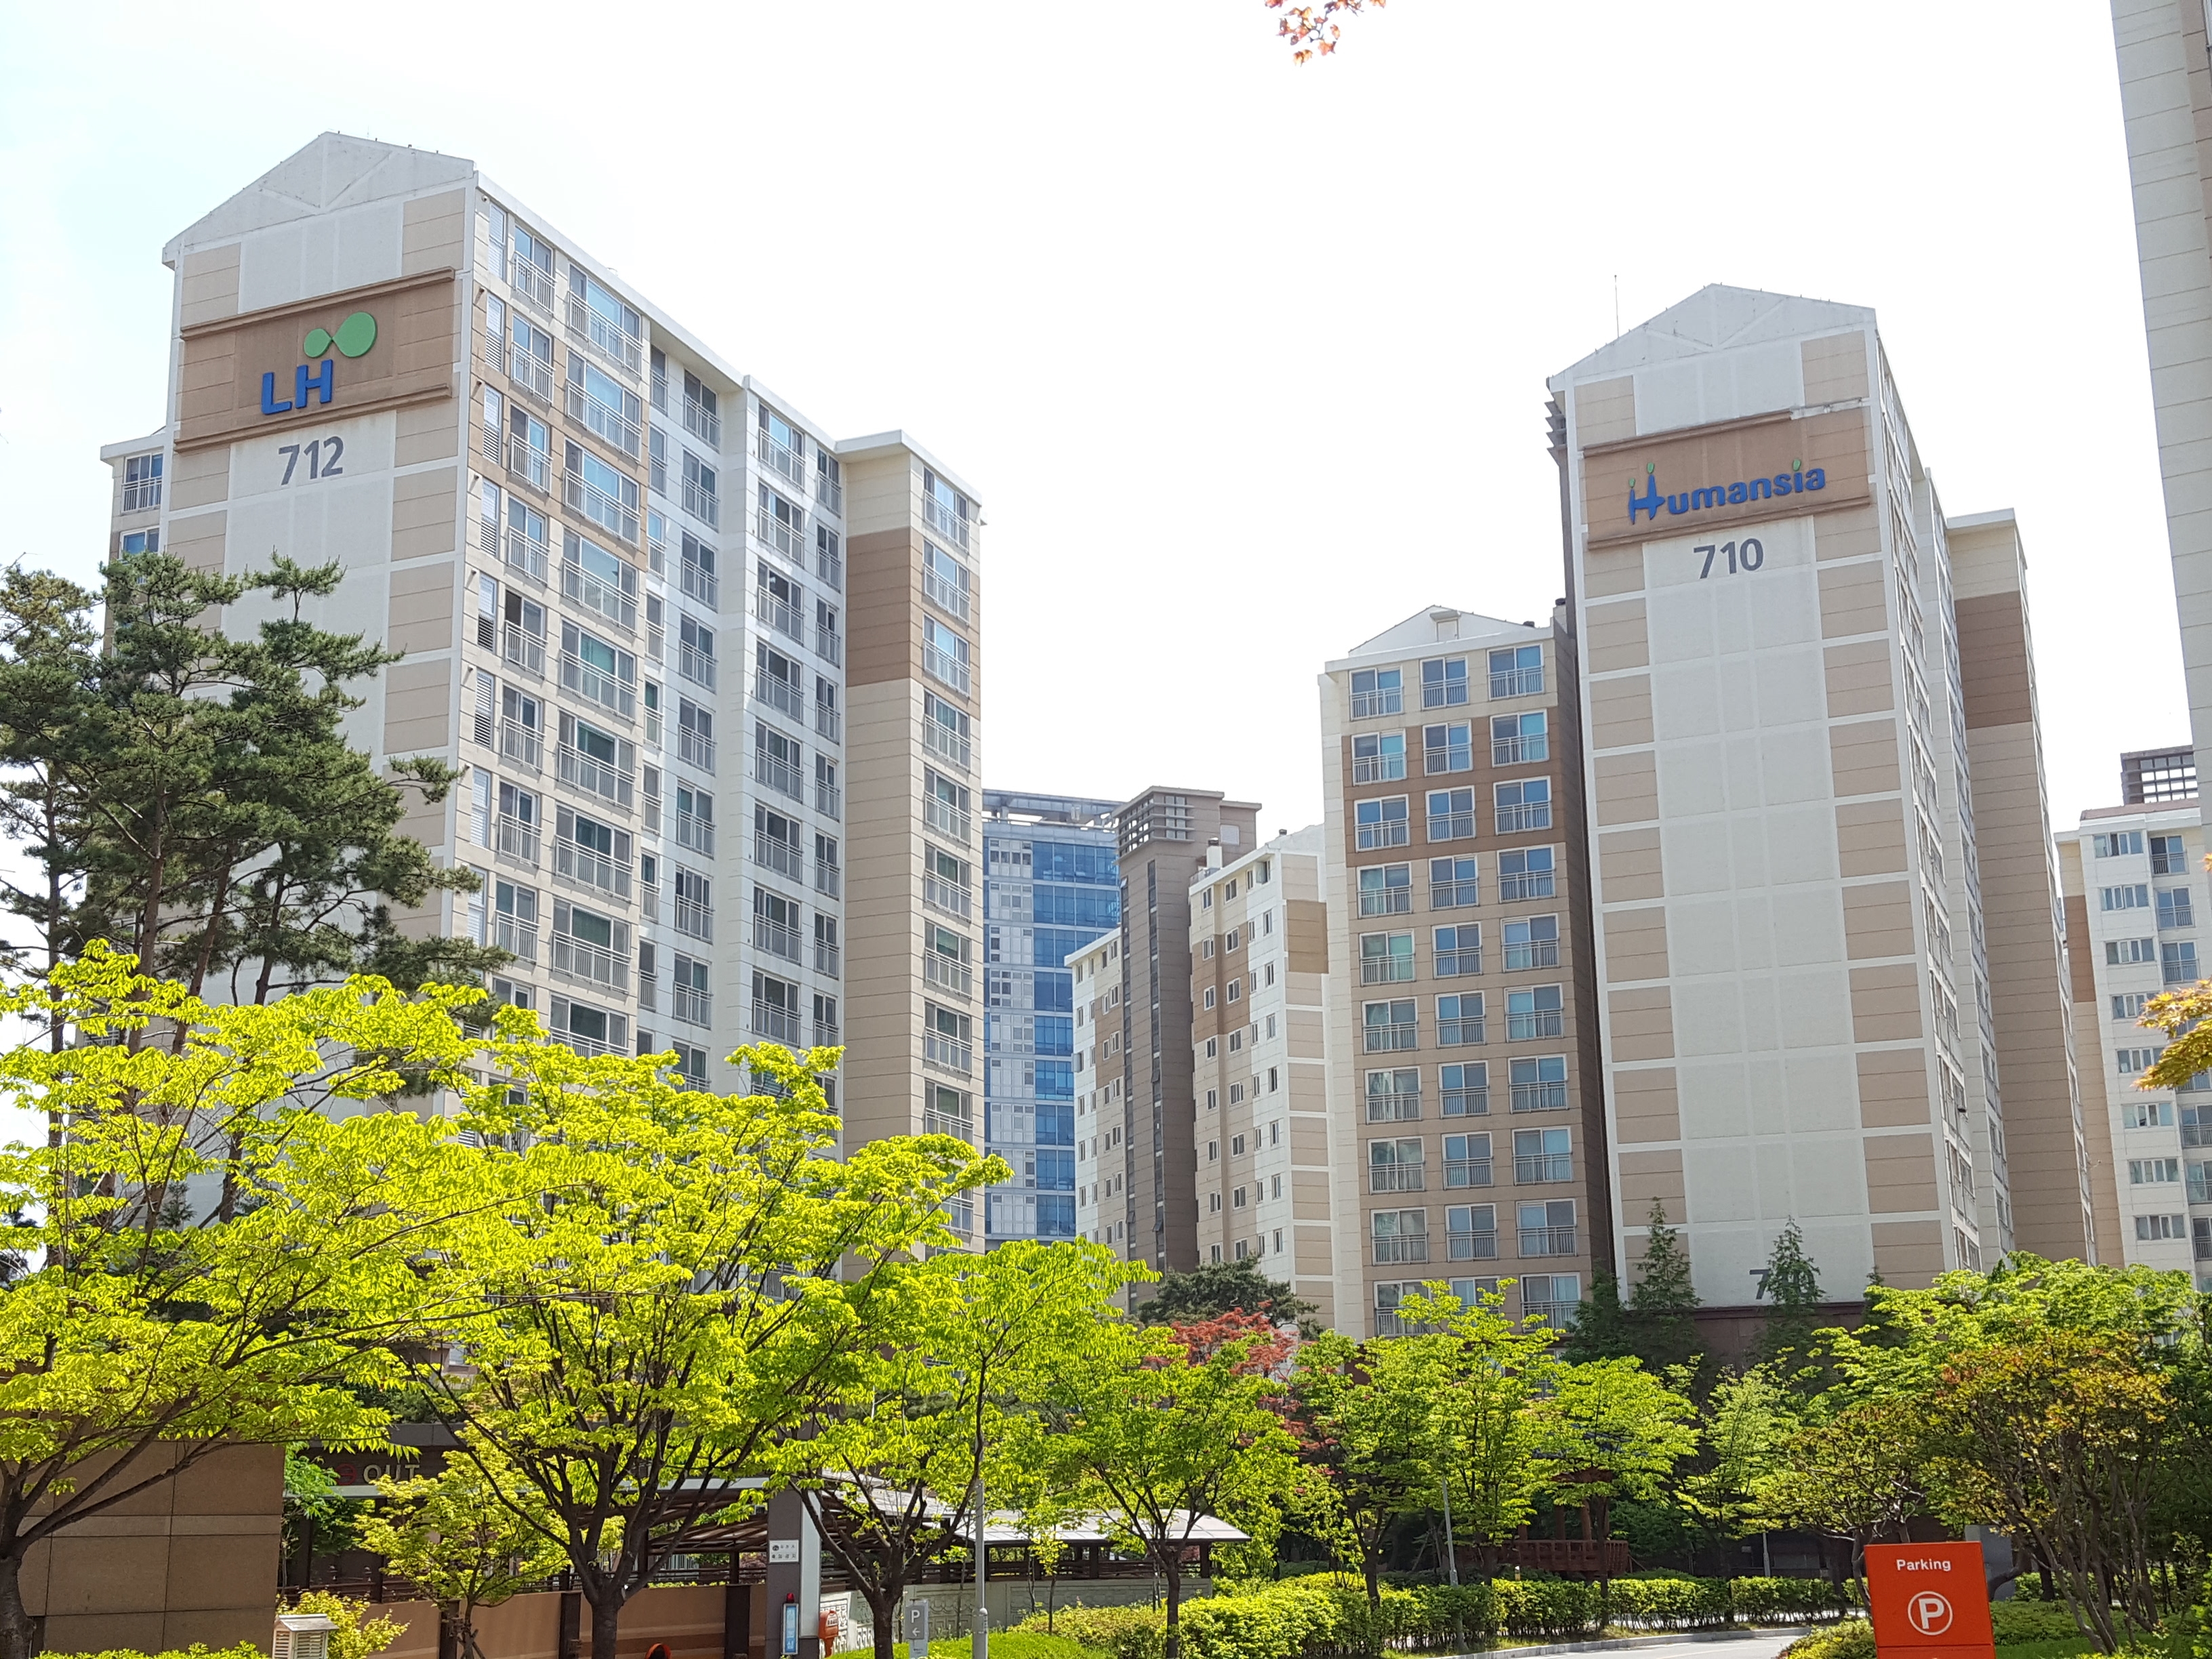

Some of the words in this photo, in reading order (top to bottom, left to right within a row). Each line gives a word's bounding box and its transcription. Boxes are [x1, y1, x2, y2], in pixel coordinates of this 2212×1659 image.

[261, 359, 333, 415] LH
[279, 436, 344, 486] 712
[1628, 459, 1826, 525] Humansia
[1694, 538, 1764, 579] 710
[363, 1464, 420, 1483] OUT
[1896, 1559, 1952, 1572] Parking
[911, 1610, 920, 1624] P
[1919, 1598, 1945, 1630] P
